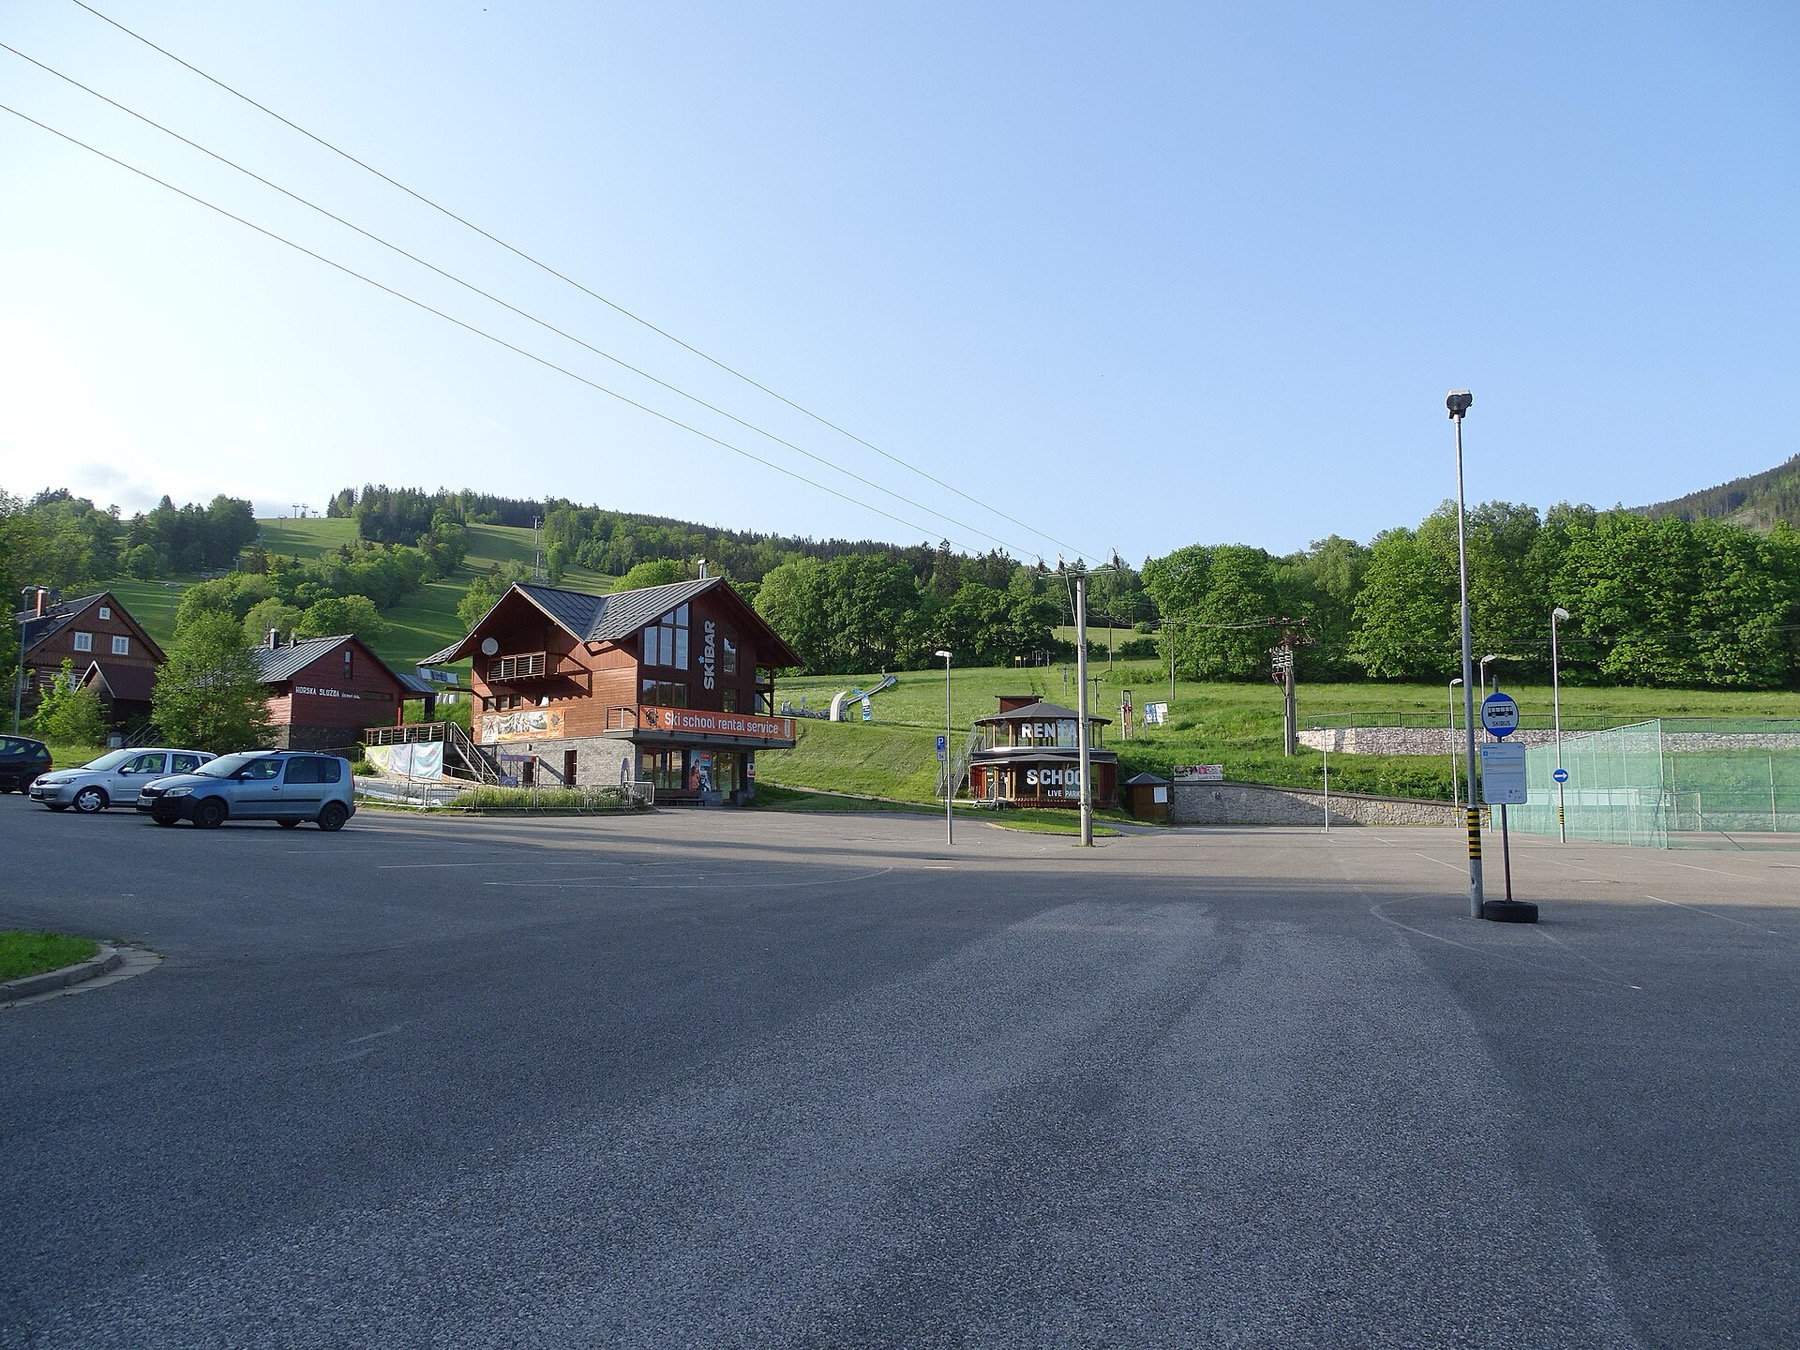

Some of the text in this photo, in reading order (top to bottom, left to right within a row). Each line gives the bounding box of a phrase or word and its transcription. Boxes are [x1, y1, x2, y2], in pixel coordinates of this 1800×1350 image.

[701, 620, 716, 690] SKIBAR
[664, 711, 681, 726] Ski
[682, 714, 716, 729] school
[718, 717, 745, 732] rental
[747, 721, 779, 735] service
[1021, 722, 1077, 738] RENTA
[1026, 768, 1081, 785] SCHOO
[1047, 789, 1062, 797] LIVE
